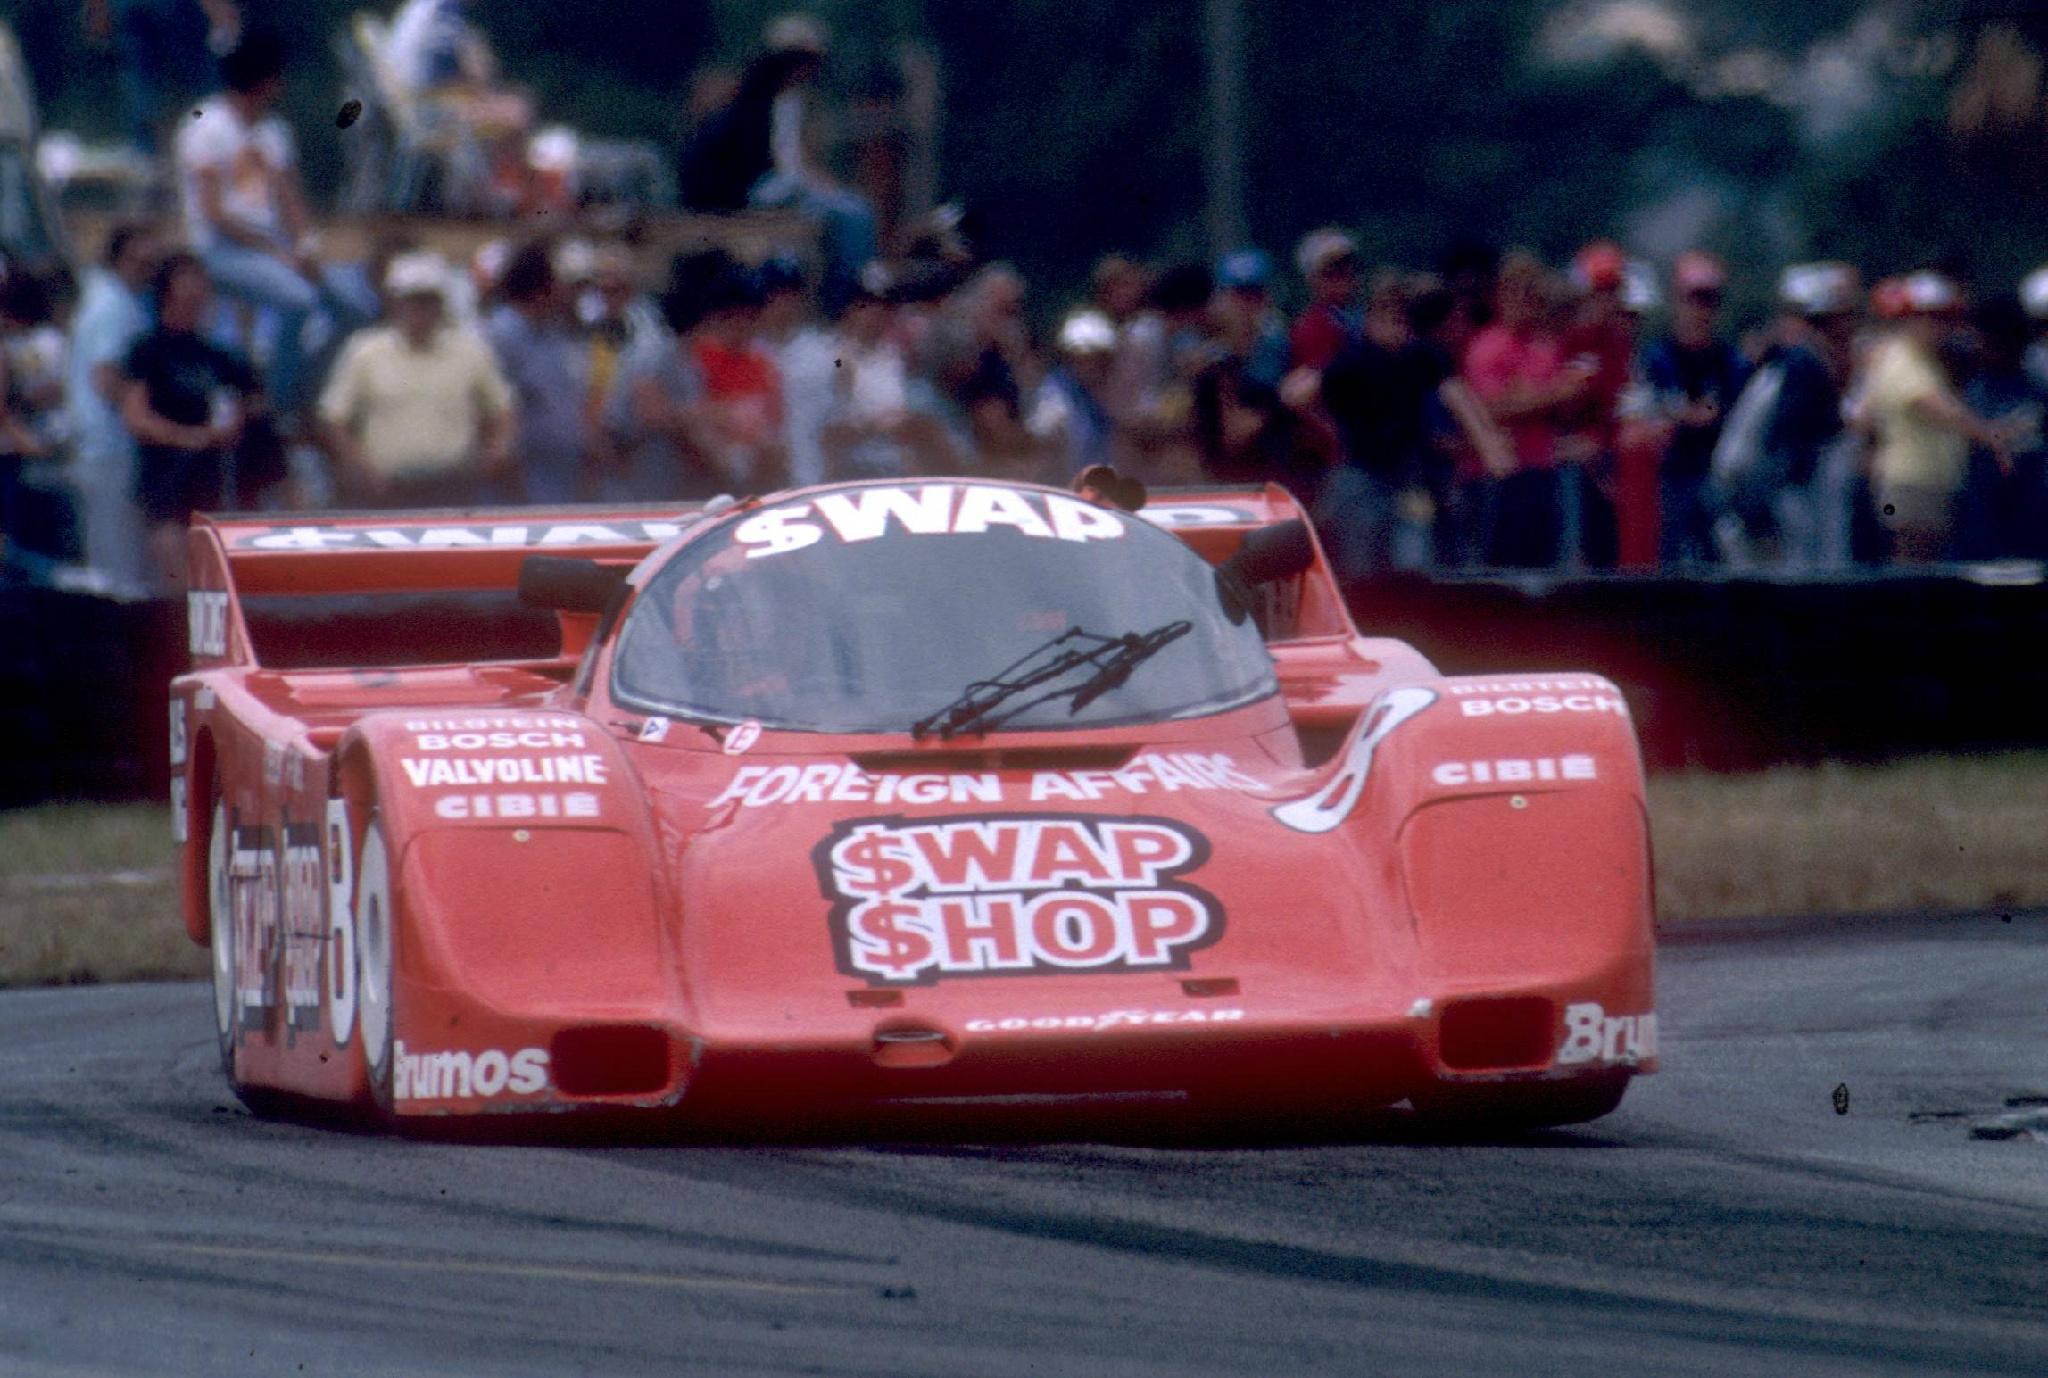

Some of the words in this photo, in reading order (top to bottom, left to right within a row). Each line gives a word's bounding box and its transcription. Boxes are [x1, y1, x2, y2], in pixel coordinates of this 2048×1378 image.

[735, 484, 1125, 559] $WAP
[1460, 694, 1627, 718] BOSCH
[404, 717, 580, 732] BILSTEIN
[416, 732, 586, 751] BOSCH
[401, 754, 609, 787] VALVOLINE
[705, 764, 1002, 808] FOREIGN
[1030, 752, 1271, 802] AFFAIRS
[1432, 752, 1597, 786] CIBIE
[434, 791, 602, 819] CIBIE
[831, 820, 1193, 899] $WAP
[847, 891, 1211, 980] $HOP
[964, 1008, 1240, 1032] GOODYEAR
[393, 1040, 550, 1100] rumos
